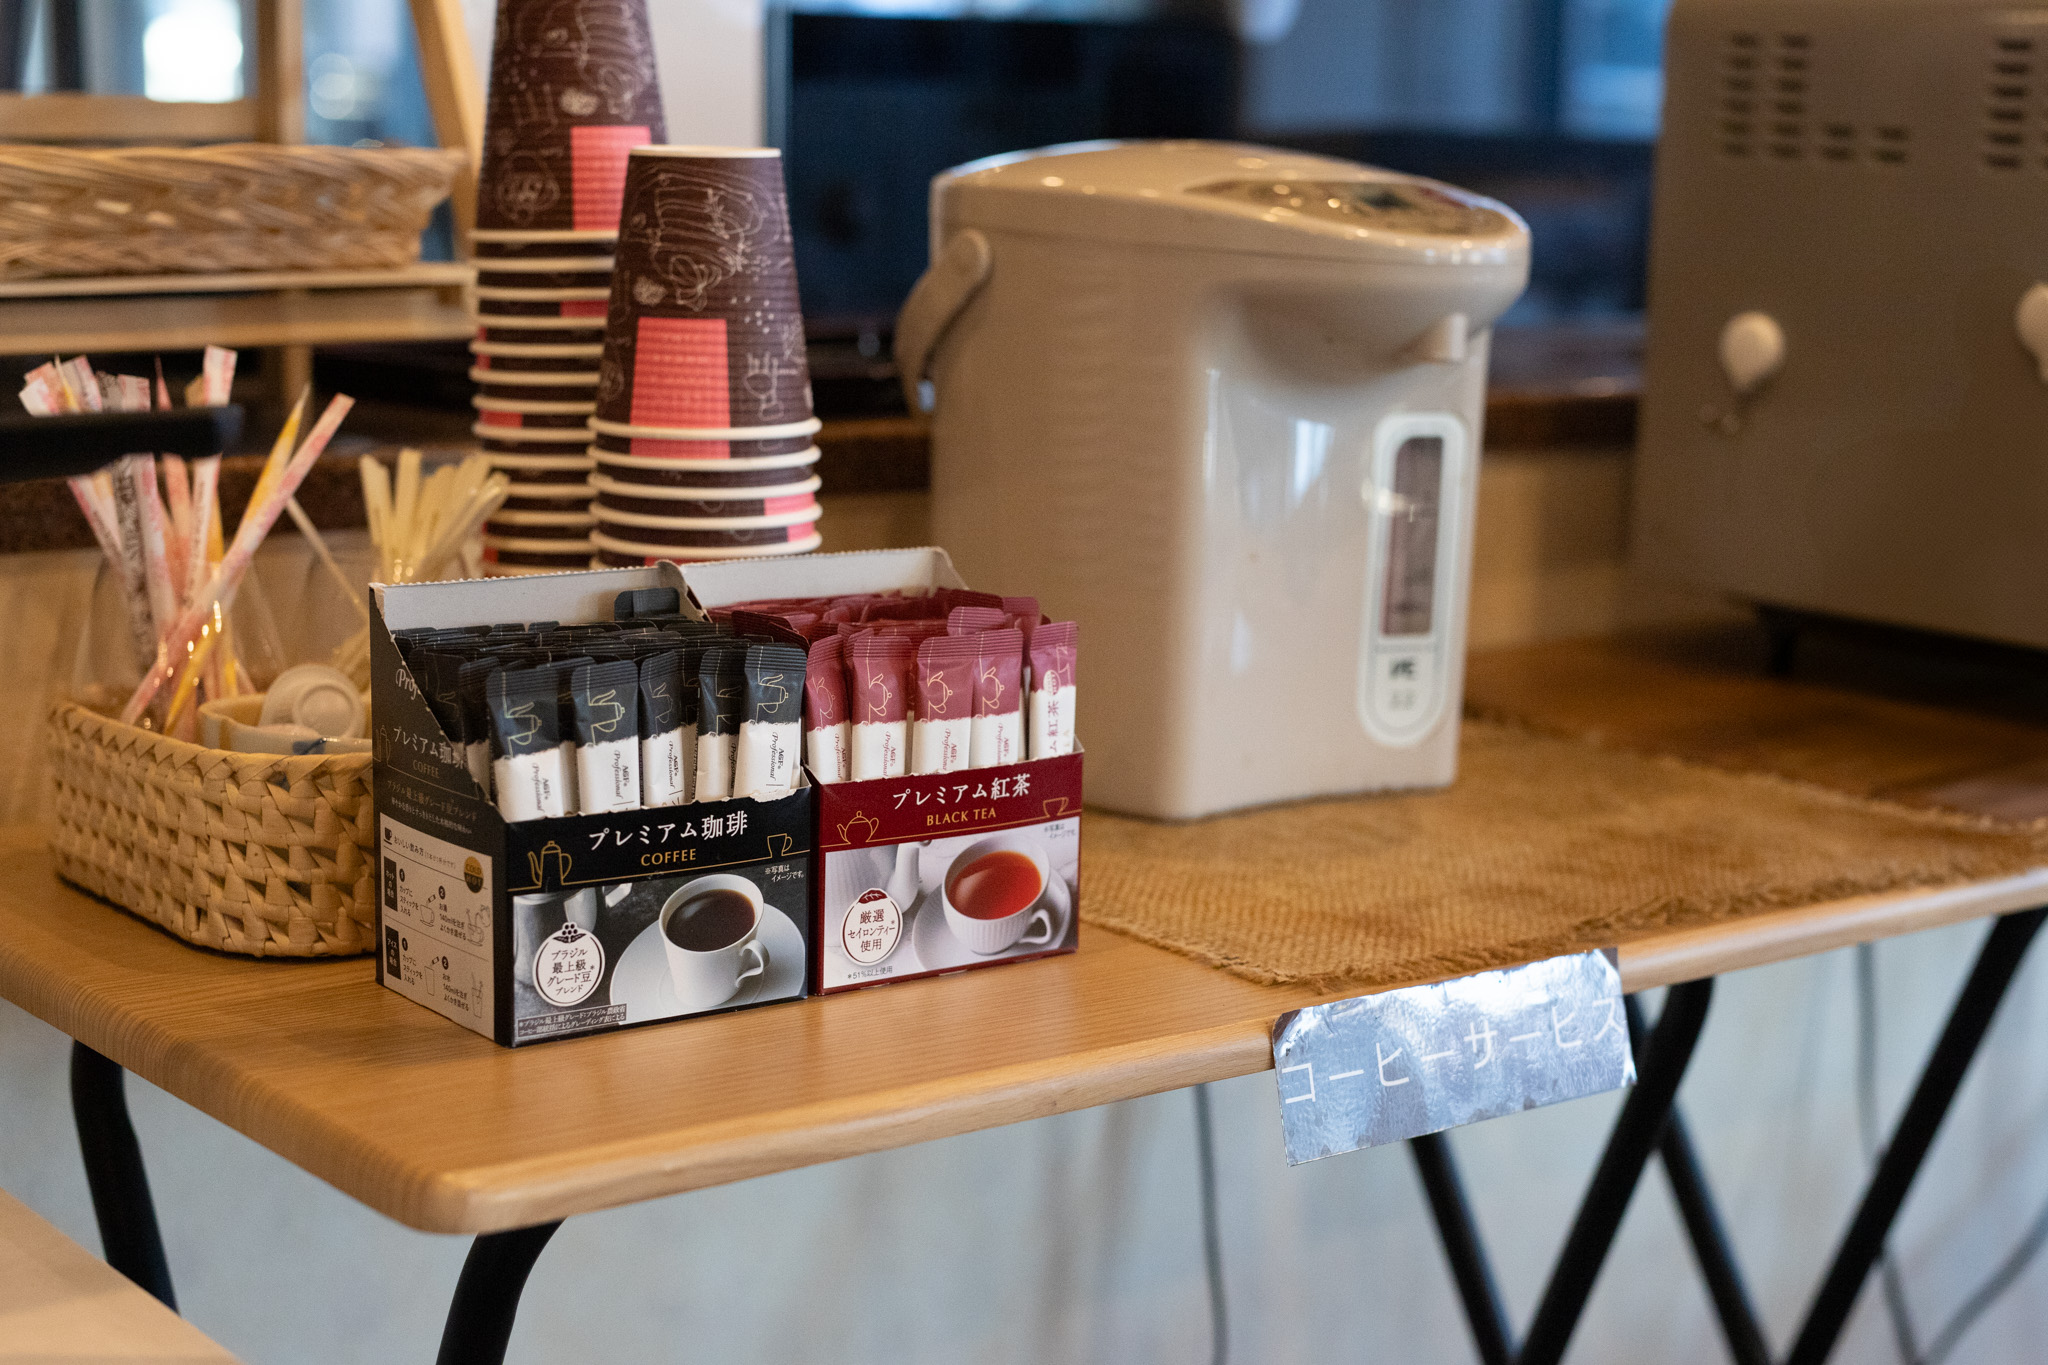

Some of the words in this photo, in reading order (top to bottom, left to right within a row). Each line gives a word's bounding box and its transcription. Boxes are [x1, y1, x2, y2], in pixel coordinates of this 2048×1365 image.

[767, 731, 779, 781] Professional
[412, 759, 440, 779] COFFEE
[892, 773, 1031, 810] プレミアム紅茶
[926, 810, 968, 826] BLACK
[973, 807, 997, 820] TEA
[588, 810, 748, 850] プレミアム珈琲
[640, 848, 697, 866] COFFEE
[860, 908, 885, 925] 厳選
[847, 924, 896, 939] セイロンティー
[551, 947, 588, 961] ブラジル
[860, 938, 882, 953] 使用
[552, 959, 587, 975] 最上級
[547, 971, 592, 987] グレード豆
[555, 984, 584, 996] ブレンド
[1281, 998, 1625, 1105] コーヒーサービス
